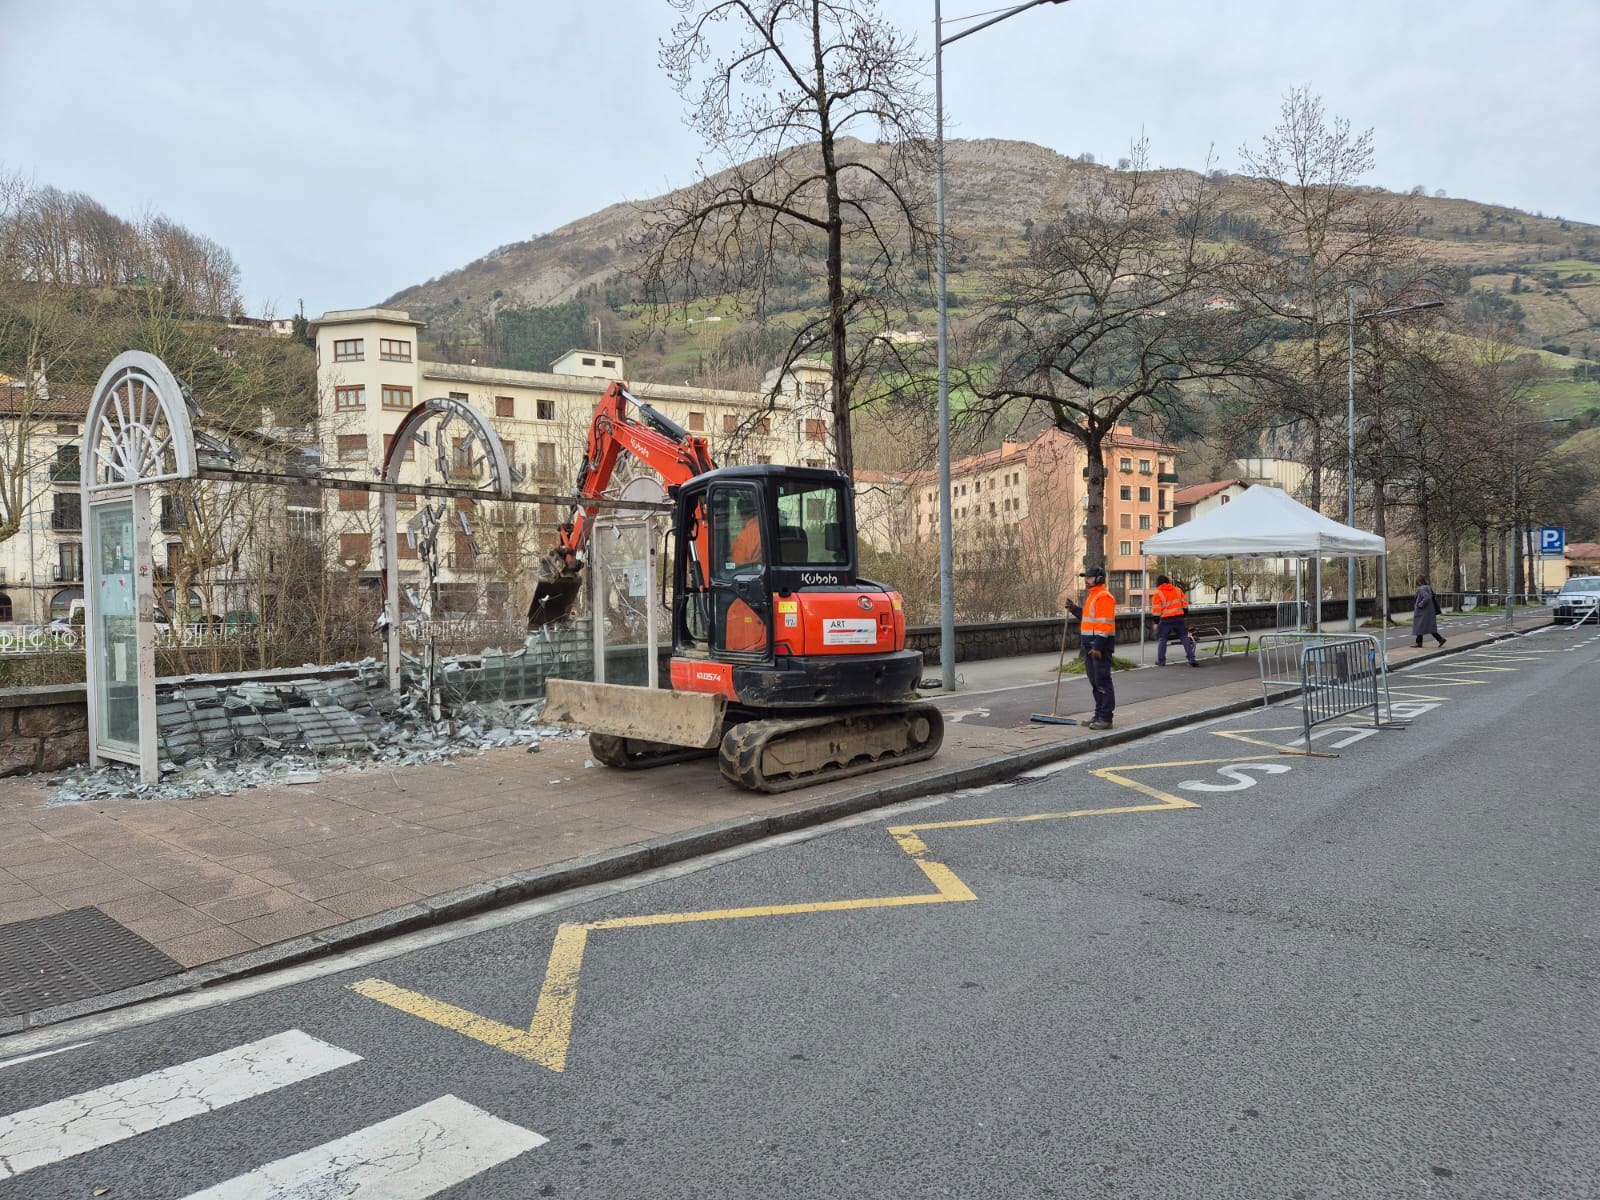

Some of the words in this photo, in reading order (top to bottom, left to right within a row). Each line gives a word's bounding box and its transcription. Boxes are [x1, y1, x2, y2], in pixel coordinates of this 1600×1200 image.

[630, 437, 649, 459] Kubota
[1543, 530, 1559, 548] P
[801, 572, 838, 585] Kubota
[830, 620, 846, 629] ART
